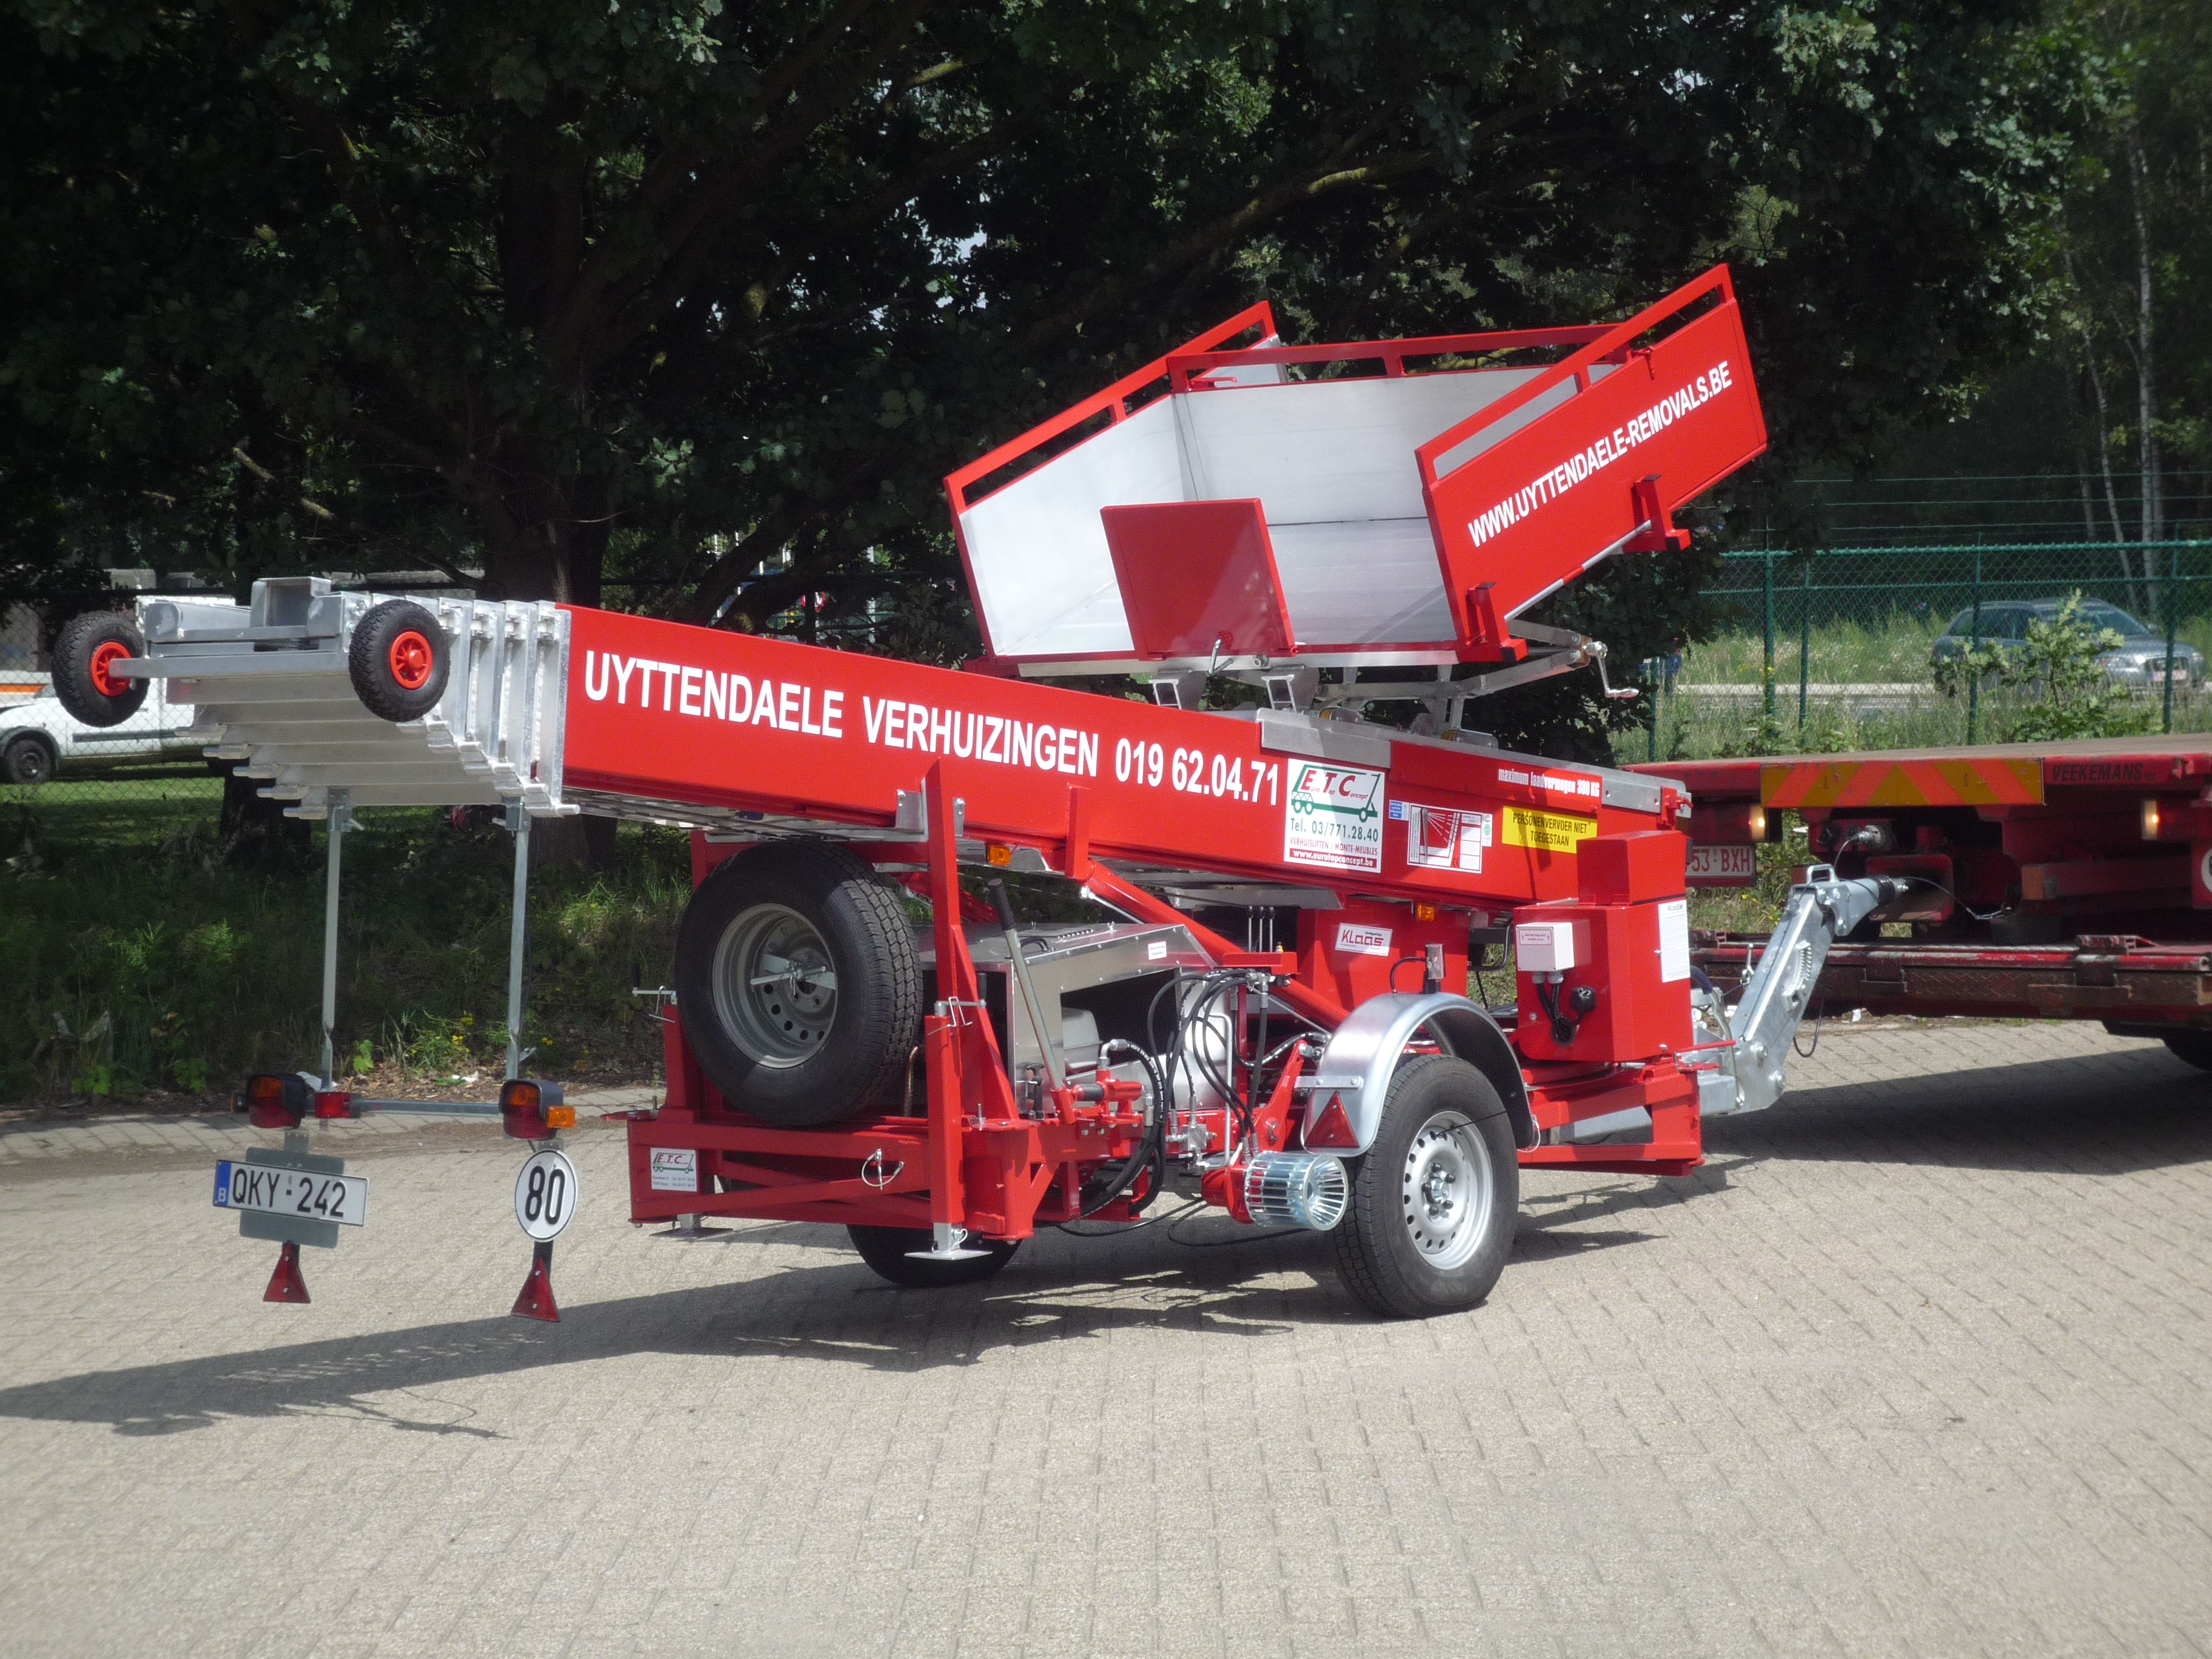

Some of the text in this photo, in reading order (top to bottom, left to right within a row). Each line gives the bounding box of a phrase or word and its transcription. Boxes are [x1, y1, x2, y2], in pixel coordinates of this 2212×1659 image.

[1468, 361, 1732, 547] WWW.UYTTENDAELE-REMOVALS.BE
[585, 650, 1279, 806] UYTTENDAELE VERHUIZINGEN 019 62.04.71
[1498, 768, 1600, 797] maximum laadvermogen 300 KG
[2053, 762, 2144, 782] VEEKEMANS
[1290, 818, 1378, 842] Tel. 03/771.28.40
[1513, 813, 1588, 834] PERSONENVERVOER NIET
[1289, 836, 1329, 850] VERHUISLIFTEN
[1335, 843, 1378, 856] MONTE-MEUBLES
[1530, 830, 1569, 846] TOEGESTAAN
[1293, 850, 1373, 866] www.eurotopconcept.be
[218, 1168, 347, 1218] B QKY-242
[525, 1165, 566, 1225] 80
